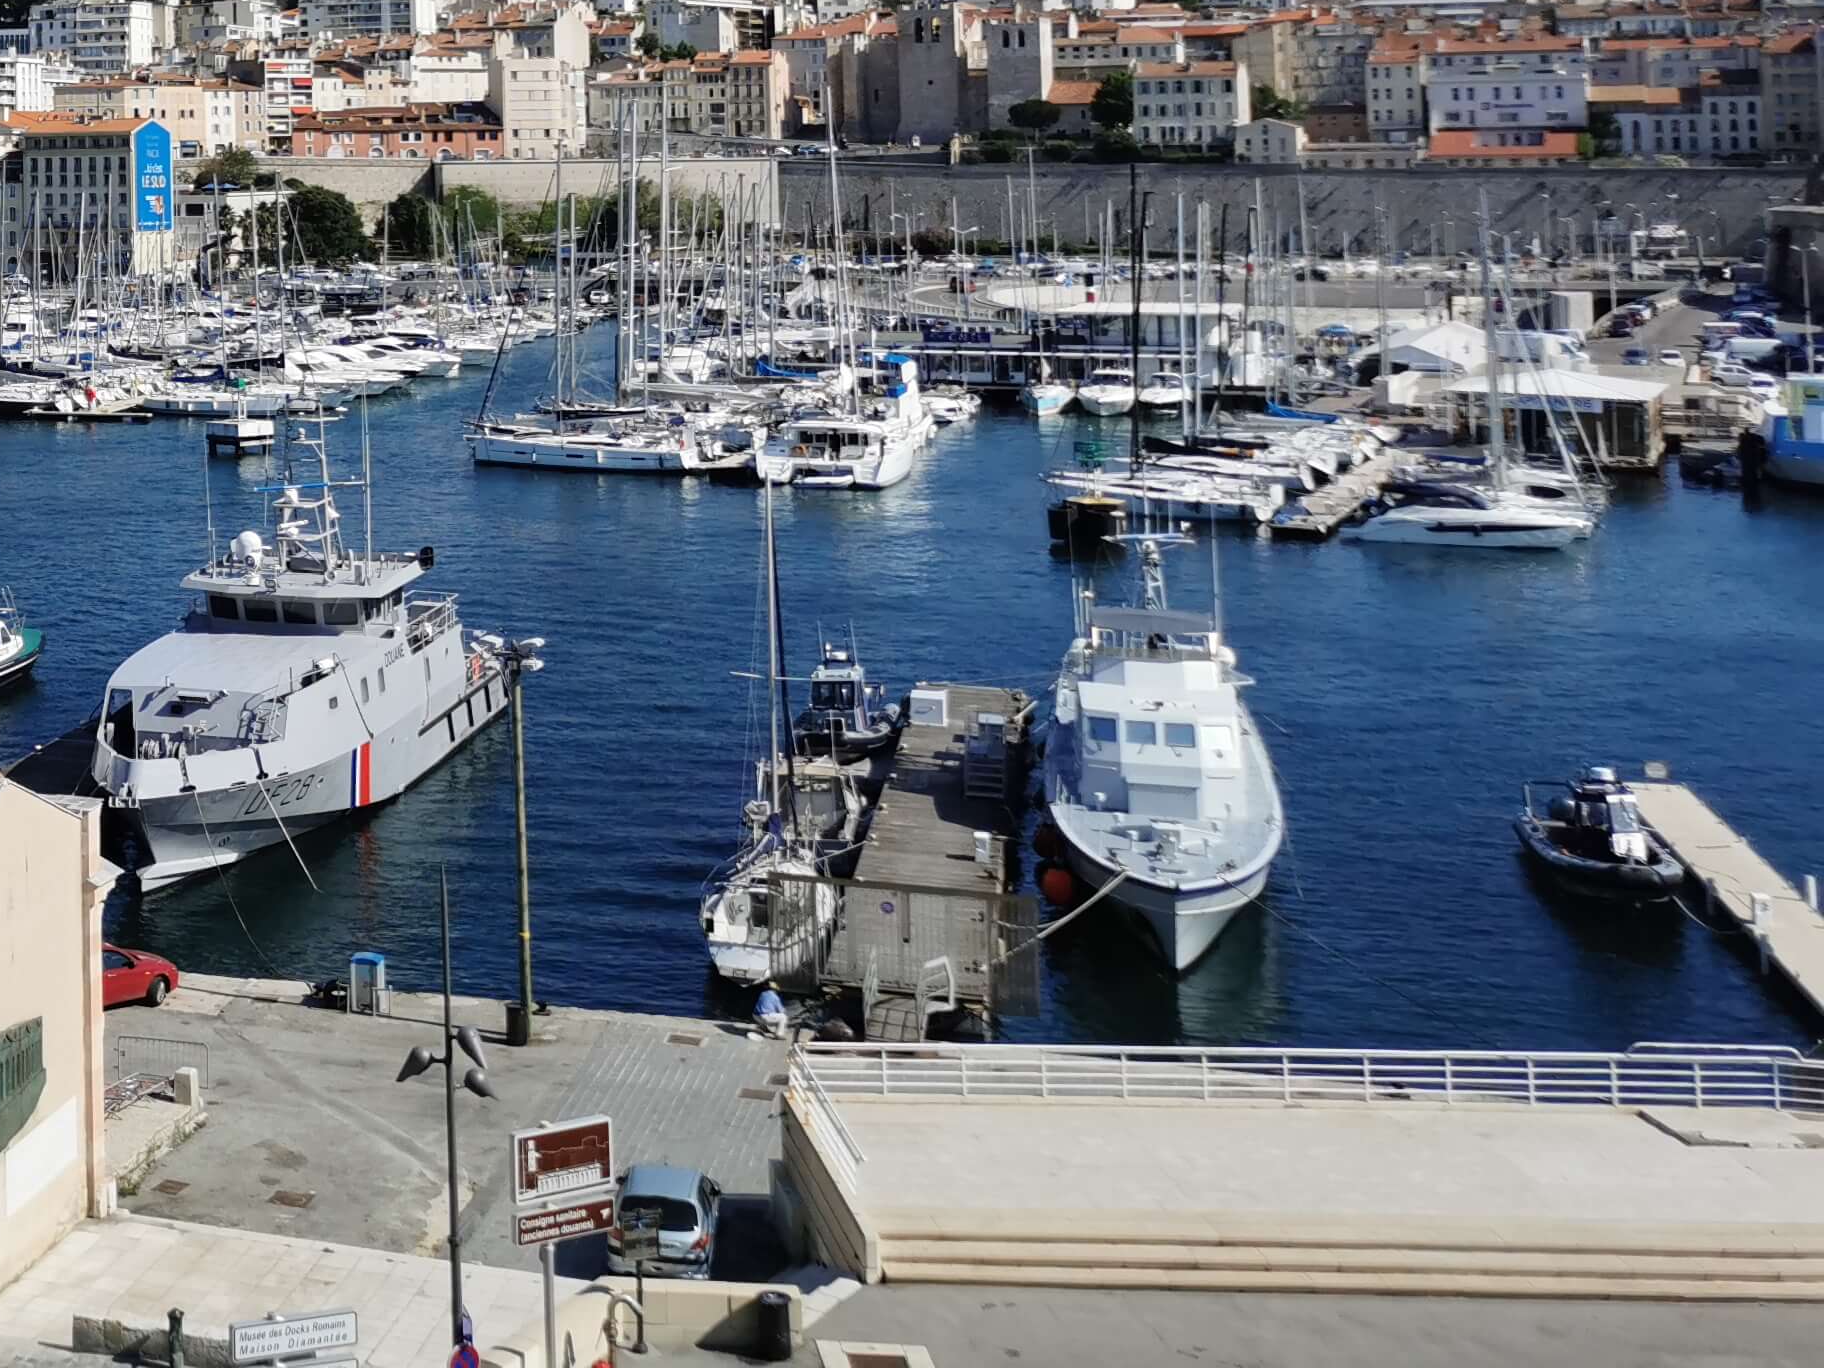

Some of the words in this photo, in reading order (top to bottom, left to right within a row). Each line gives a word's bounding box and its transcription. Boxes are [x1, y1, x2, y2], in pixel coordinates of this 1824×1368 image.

[244, 773, 315, 816] DF28
[520, 1215, 555, 1230] Consigne
[556, 1208, 587, 1220] sanitaire
[520, 1227, 560, 1244] (anciennes
[561, 1218, 594, 1233] douanes)
[239, 1330, 266, 1343] Musée
[269, 1327, 282, 1338] des
[285, 1324, 309, 1337] Docks
[312, 1319, 346, 1332] Romains
[239, 1343, 279, 1355] Maison
